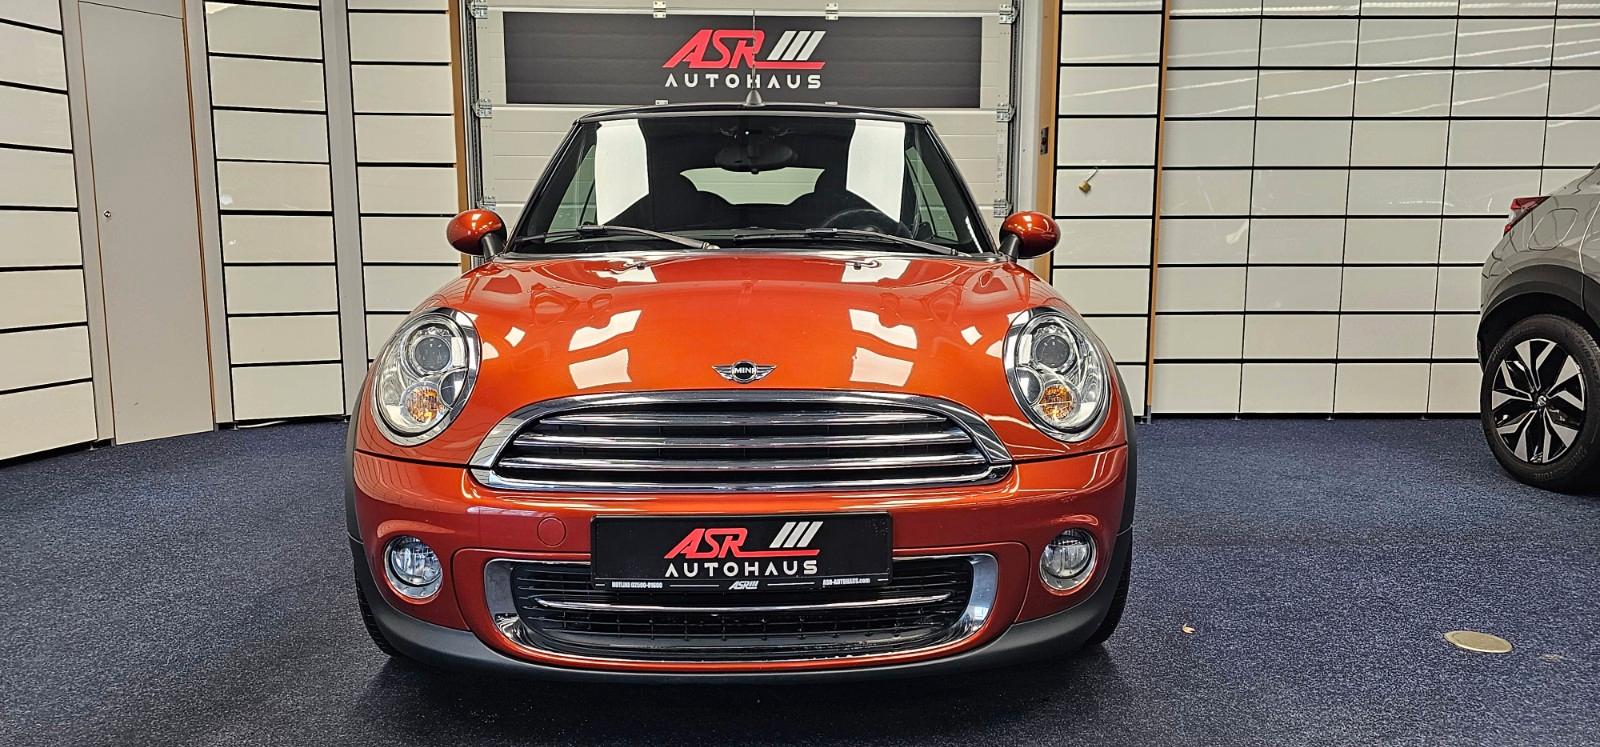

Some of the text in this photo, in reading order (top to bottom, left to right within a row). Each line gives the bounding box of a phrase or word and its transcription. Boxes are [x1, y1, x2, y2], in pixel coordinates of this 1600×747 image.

[662, 29, 826, 70] ASR
[664, 73, 822, 89] AUTOHAUS
[663, 528, 820, 559] ASR
[664, 560, 818, 577] AUTOHAUS
